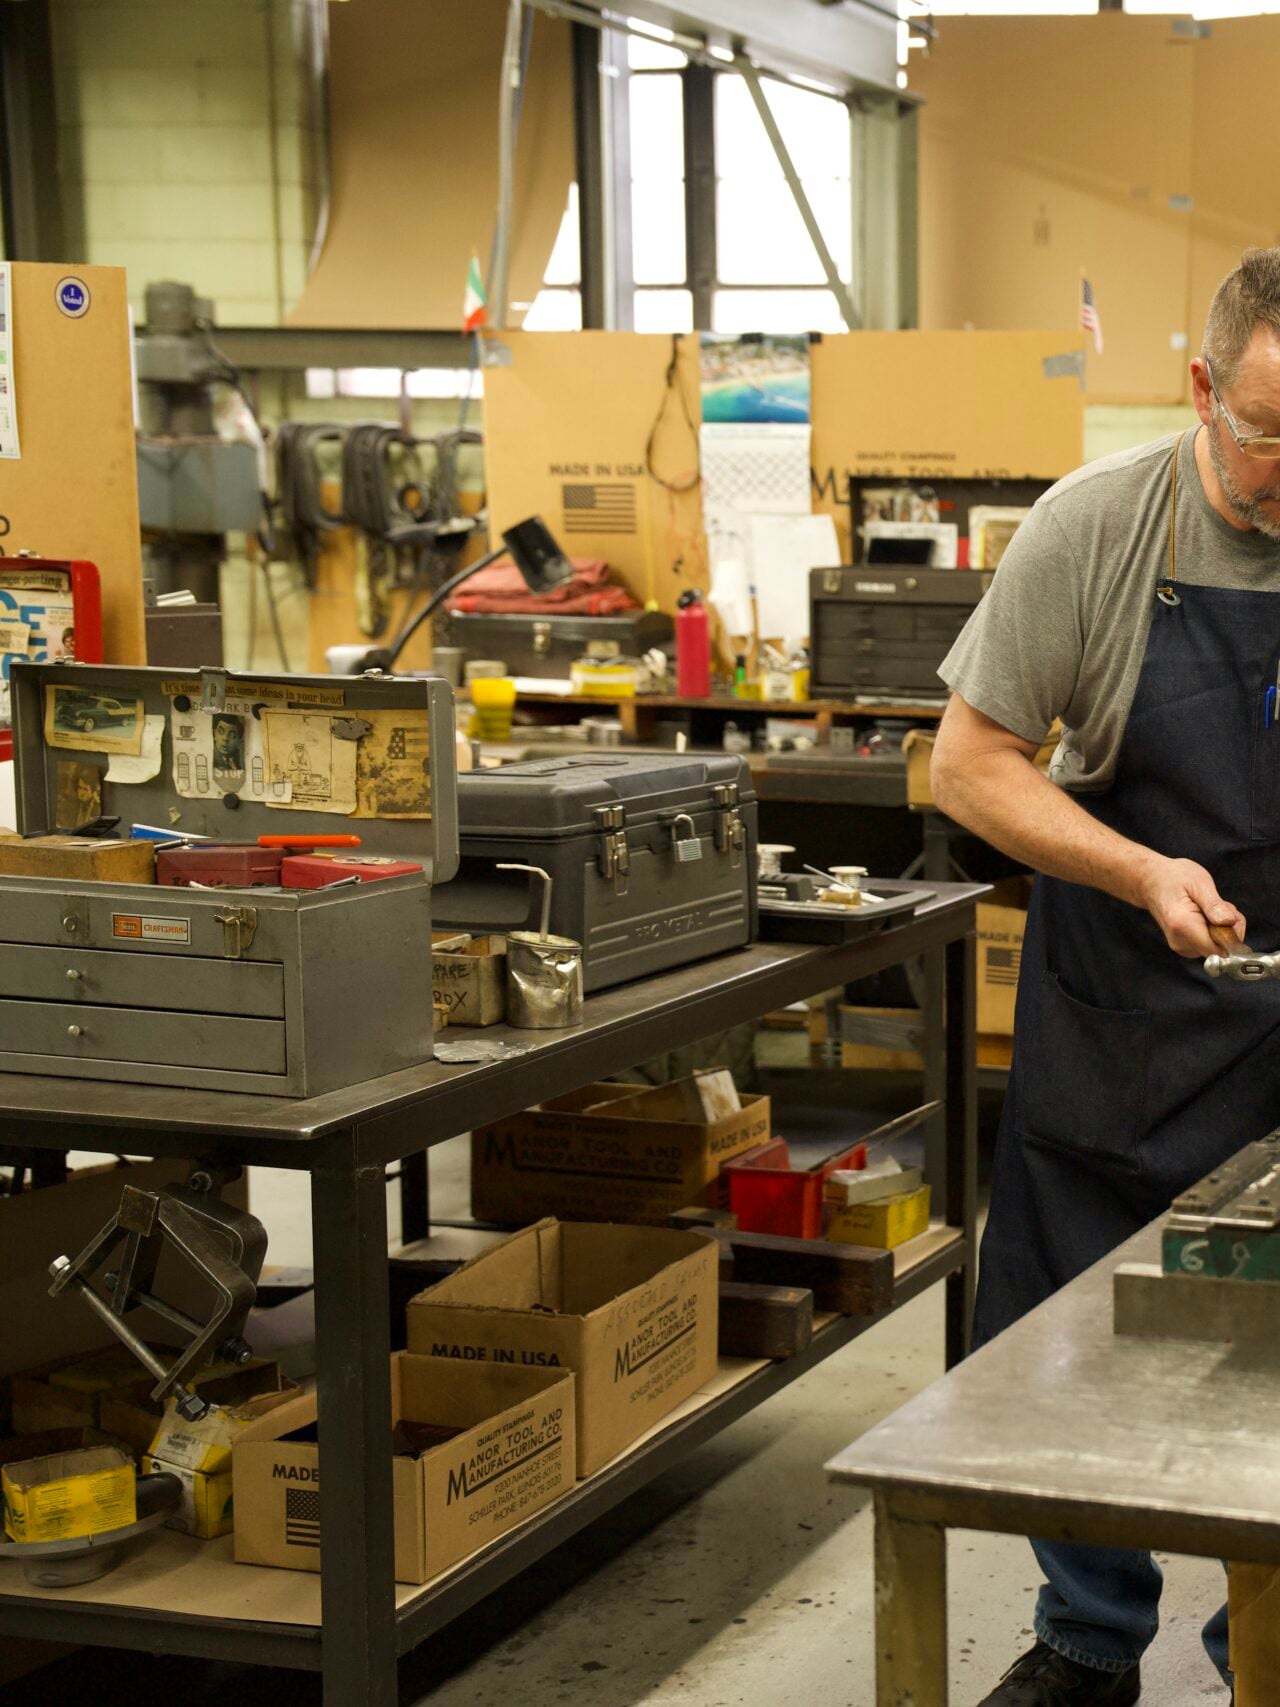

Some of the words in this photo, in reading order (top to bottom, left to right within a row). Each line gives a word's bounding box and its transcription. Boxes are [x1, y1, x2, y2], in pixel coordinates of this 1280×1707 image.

[62, 294, 83, 305] Voted
[549, 463, 589, 476] MADE
[595, 463, 611, 476] IN
[616, 463, 645, 477] USA
[259, 686, 283, 698] ideas
[286, 688, 295, 699] in
[319, 692, 343, 705] head
[214, 768, 243, 779] STOP
[143, 924, 184, 935] CRAFTSMAN
[710, 1130, 738, 1153] MADE
[739, 1126, 750, 1142] IN
[750, 1119, 768, 1137] USA
[583, 1137, 636, 1154] TOOL
[642, 1145, 682, 1161] AND
[1180, 1239, 1209, 1272] 6
[657, 1309, 679, 1329] TOOL
[682, 1293, 698, 1312] AND
[431, 1343, 487, 1361] MADE
[493, 1348, 515, 1364] IN
[522, 1351, 561, 1367] USA
[477, 1429, 502, 1448] QUALITY
[502, 1409, 536, 1434] STAMPINGS
[506, 1425, 534, 1448] TOOL
[541, 1408, 563, 1429] AND
[546, 1422, 562, 1440] CO.
[541, 1446, 562, 1467] STREET
[272, 1463, 320, 1482] MADE
[468, 1500, 497, 1526] SCHILLER
